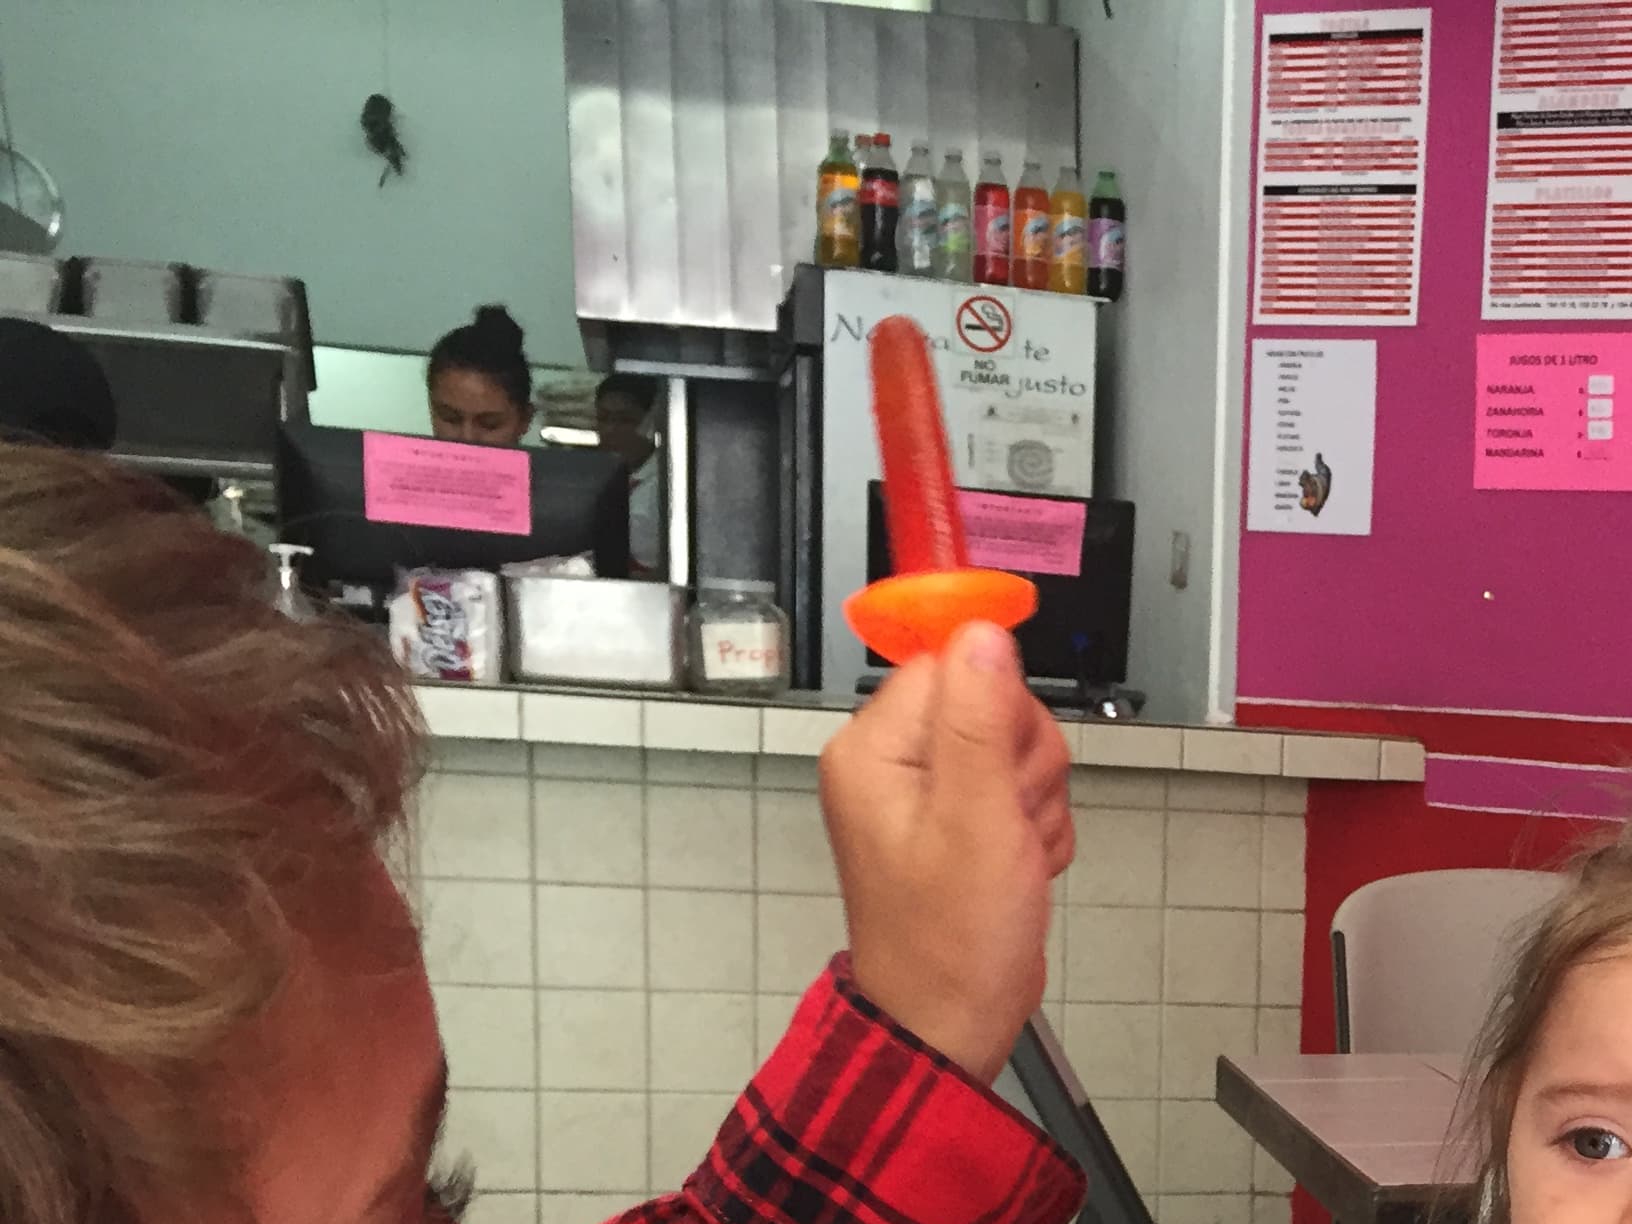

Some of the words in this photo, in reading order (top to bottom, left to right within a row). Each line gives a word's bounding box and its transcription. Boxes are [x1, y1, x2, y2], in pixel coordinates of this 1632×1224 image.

[1023, 339, 1050, 362] te
[974, 360, 996, 371] NO
[1509, 355, 1542, 366] JUGOS
[1544, 355, 1557, 365] DE
[1560, 355, 1566, 365] 1
[1569, 355, 1598, 365] LITRO
[960, 370, 1010, 386] FUMAR
[1004, 375, 1087, 399] justo
[1486, 385, 1534, 394] NARANJA
[1486, 407, 1544, 417] ZANAHORIA
[1486, 429, 1533, 439] TORONJA
[1485, 448, 1544, 458] MANDARINA
